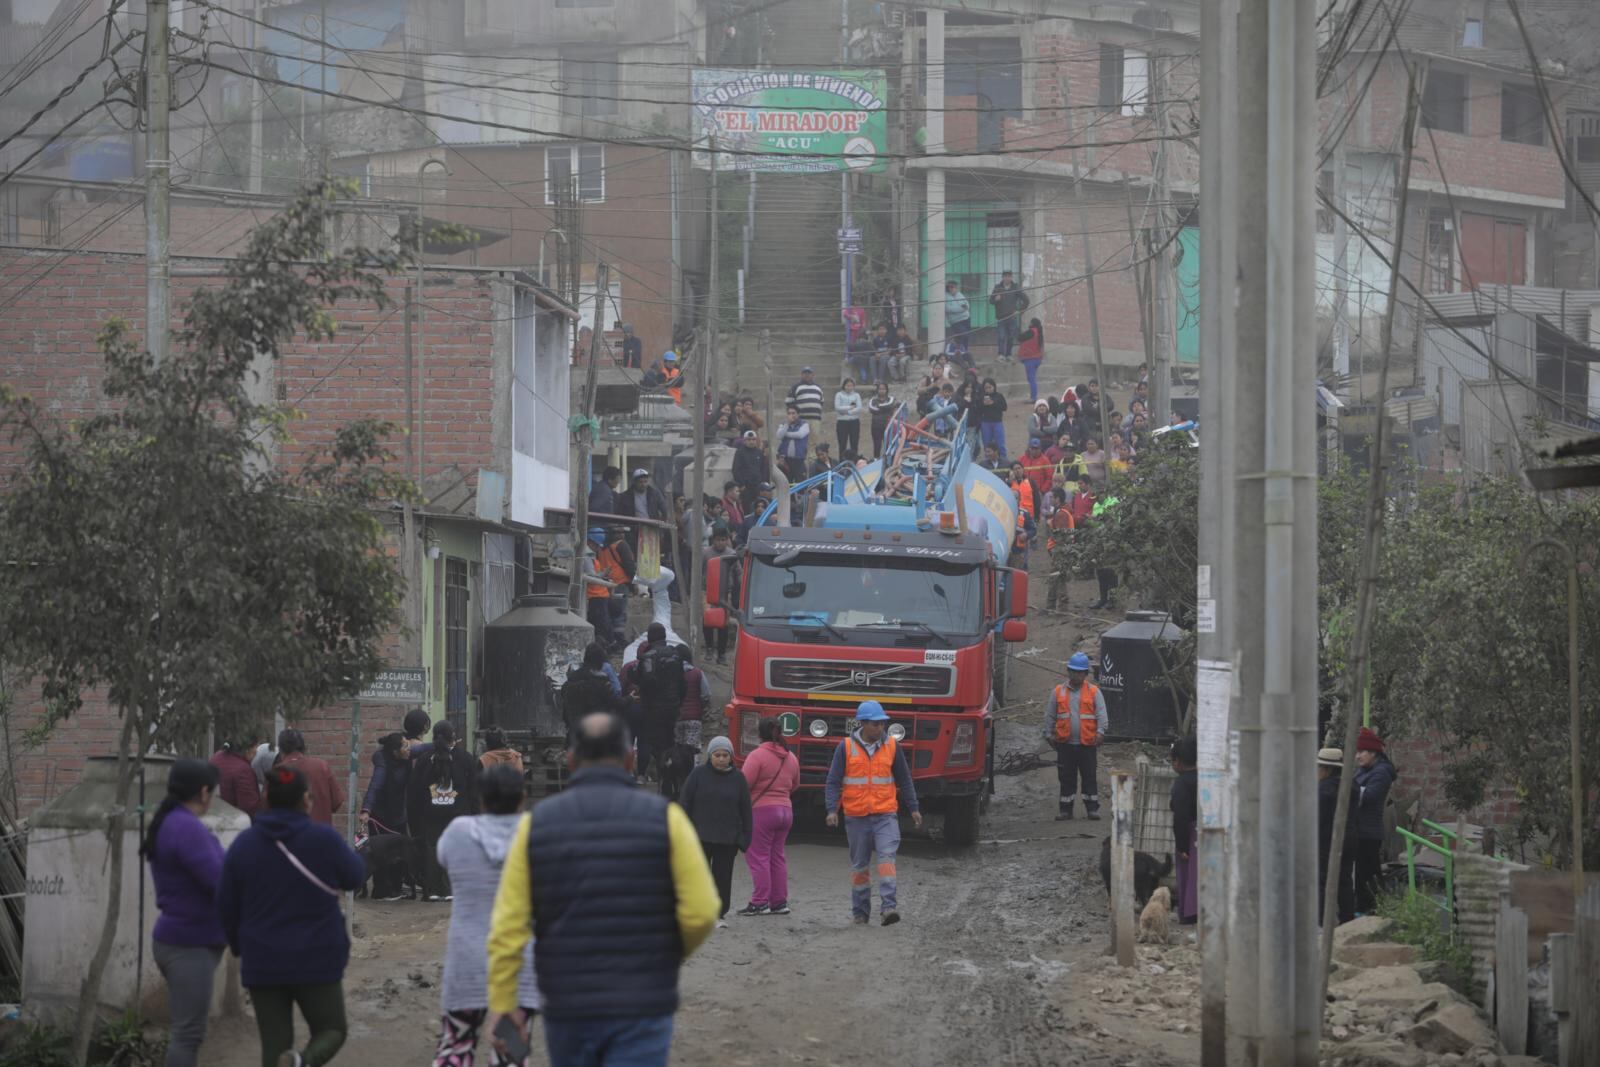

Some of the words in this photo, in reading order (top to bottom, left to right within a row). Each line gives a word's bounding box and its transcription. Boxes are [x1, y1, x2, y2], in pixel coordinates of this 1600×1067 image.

[792, 72, 811, 89] DE
[813, 75, 884, 115] VIVIENDA
[758, 111, 867, 133] MIRADOR"
[768, 137, 820, 149] "ACU"
[867, 544, 893, 553] De
[389, 672, 422, 681] CLAVELES
[783, 717, 794, 732] L
